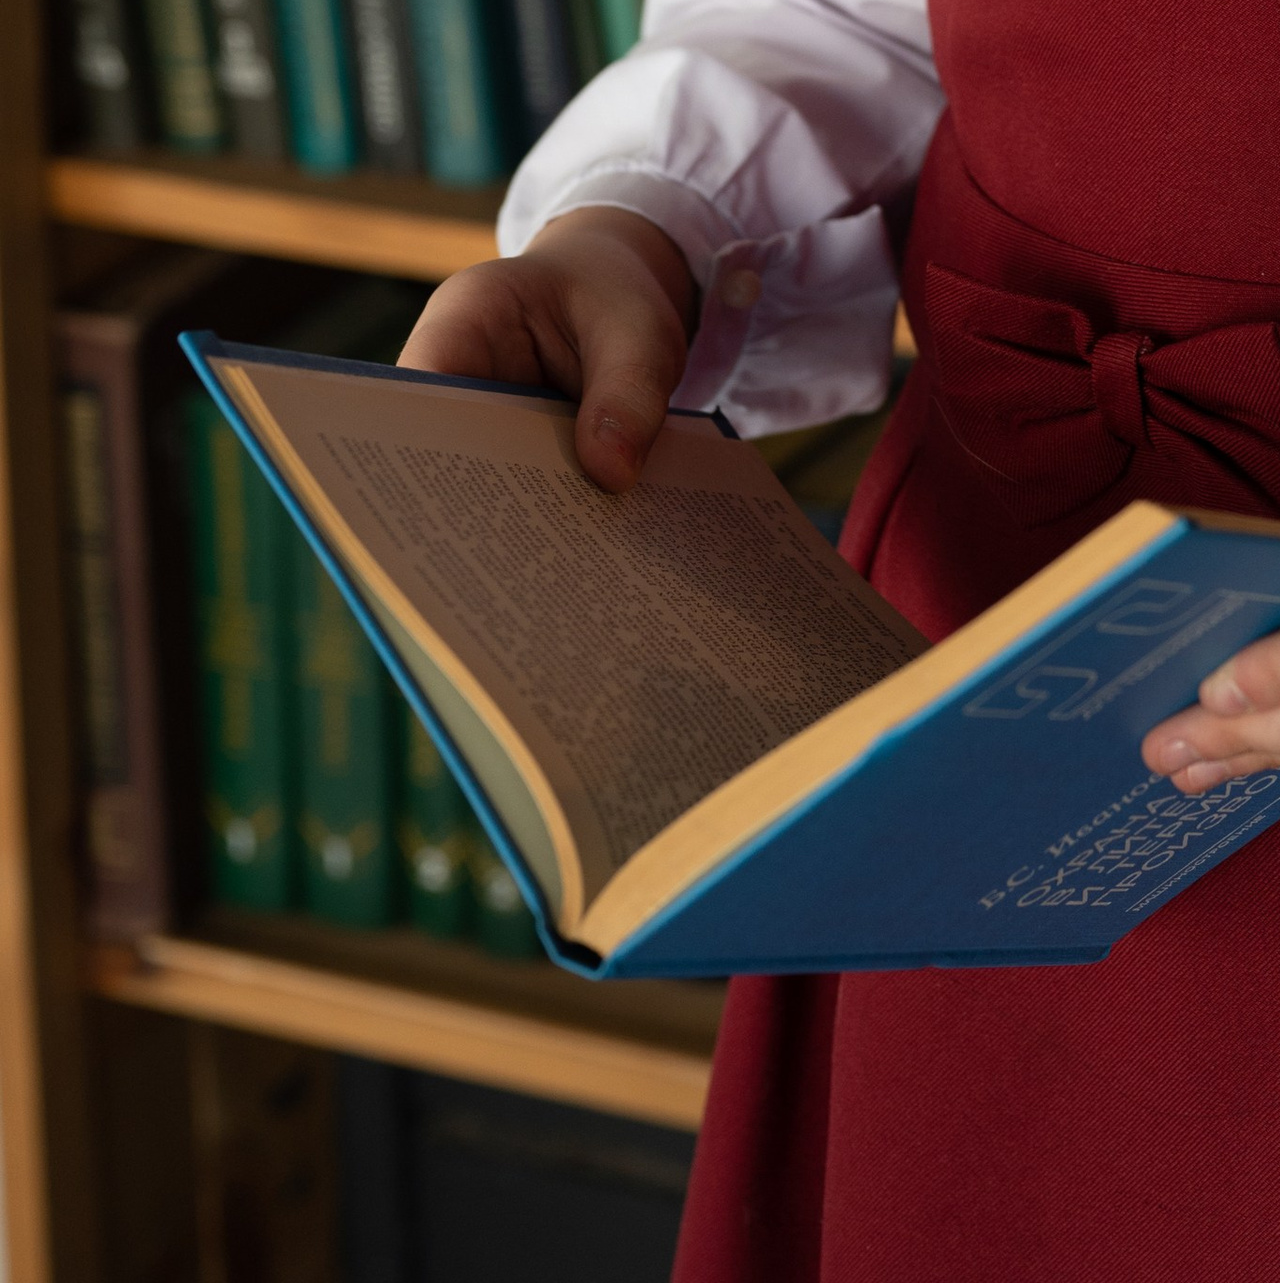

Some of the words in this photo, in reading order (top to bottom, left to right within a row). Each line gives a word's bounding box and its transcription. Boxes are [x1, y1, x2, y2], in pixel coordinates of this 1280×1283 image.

[1016, 795, 1178, 908] ОХРАНА
[1066, 886, 1106, 907] И
[1107, 774, 1252, 875] ТЕРМИ
[1131, 814, 1267, 913] МАШИНОСТРОЕНИЕ
[1041, 887, 1075, 907] В
